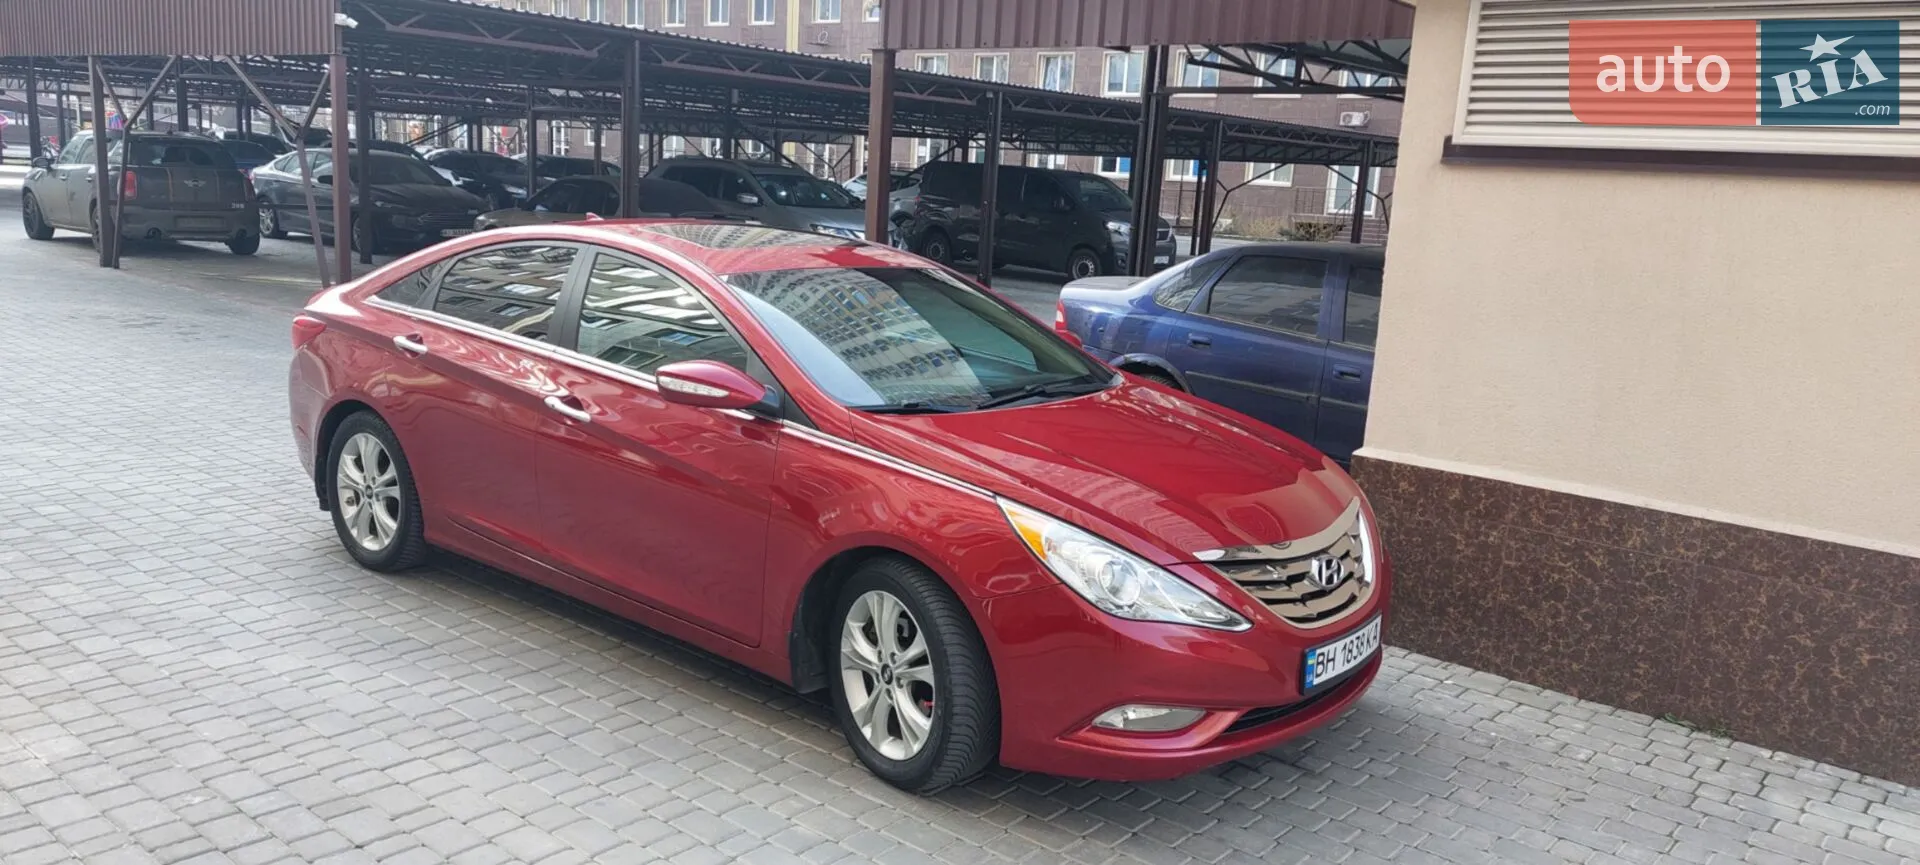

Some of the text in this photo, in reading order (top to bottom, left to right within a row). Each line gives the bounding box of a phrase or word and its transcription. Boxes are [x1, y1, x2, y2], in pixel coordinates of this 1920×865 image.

[1315, 622, 1379, 678] BH 1838 KA
